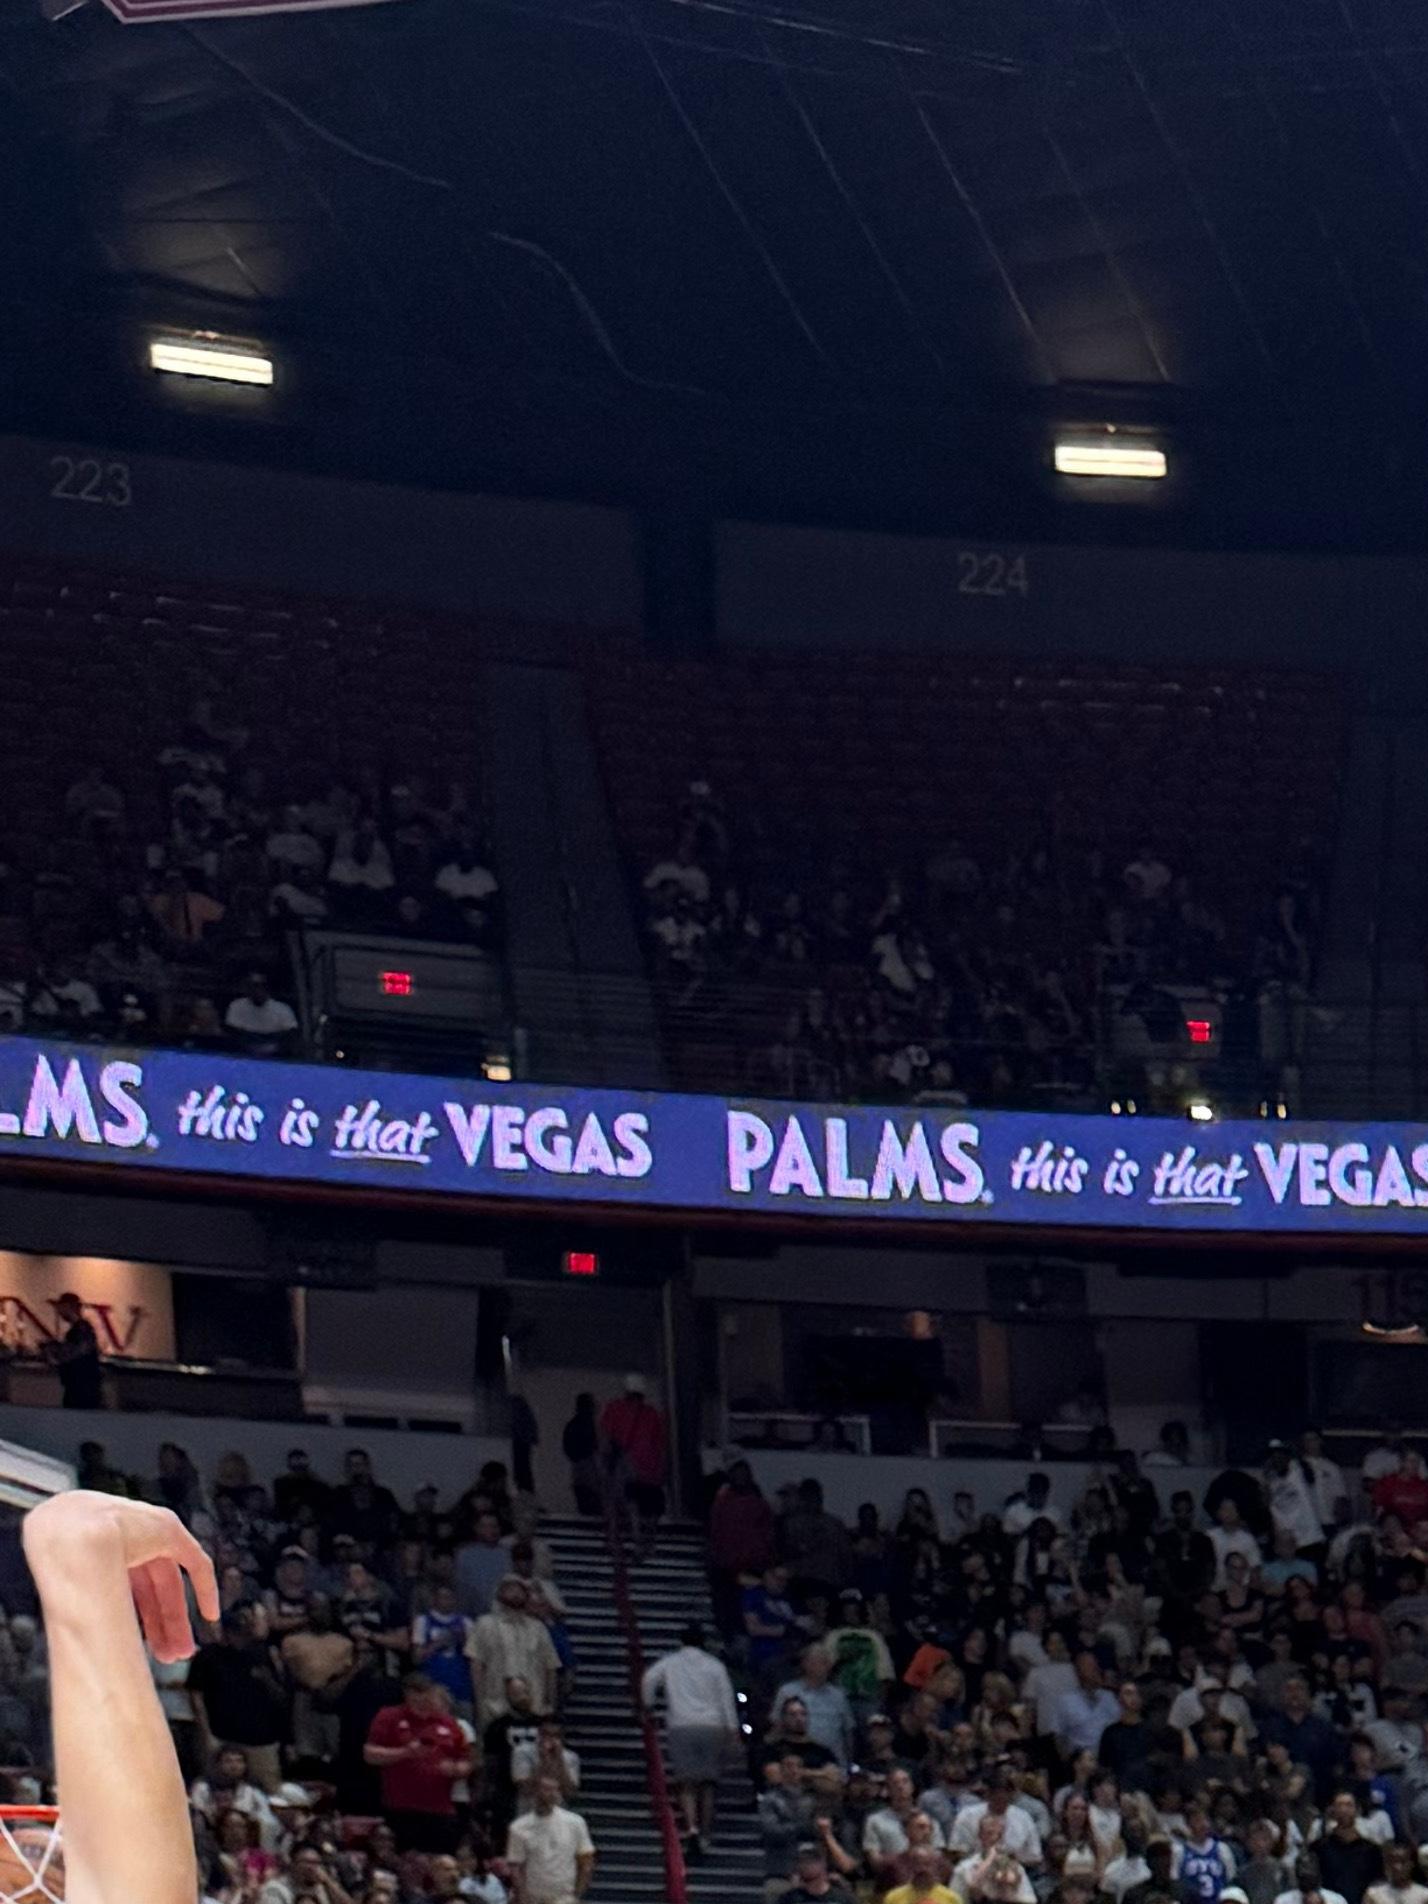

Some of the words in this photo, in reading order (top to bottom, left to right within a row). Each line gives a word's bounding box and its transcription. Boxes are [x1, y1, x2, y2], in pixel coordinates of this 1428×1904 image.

[50, 456, 132, 506] 223
[958, 551, 1029, 596] 224
[177, 1086, 264, 1144] this
[279, 1098, 320, 1148] is
[330, 1099, 439, 1164] that
[442, 1101, 654, 1178] VEGAS
[1009, 1141, 1089, 1194] this
[1104, 1148, 1140, 1196] is
[1149, 1143, 1251, 1205] that
